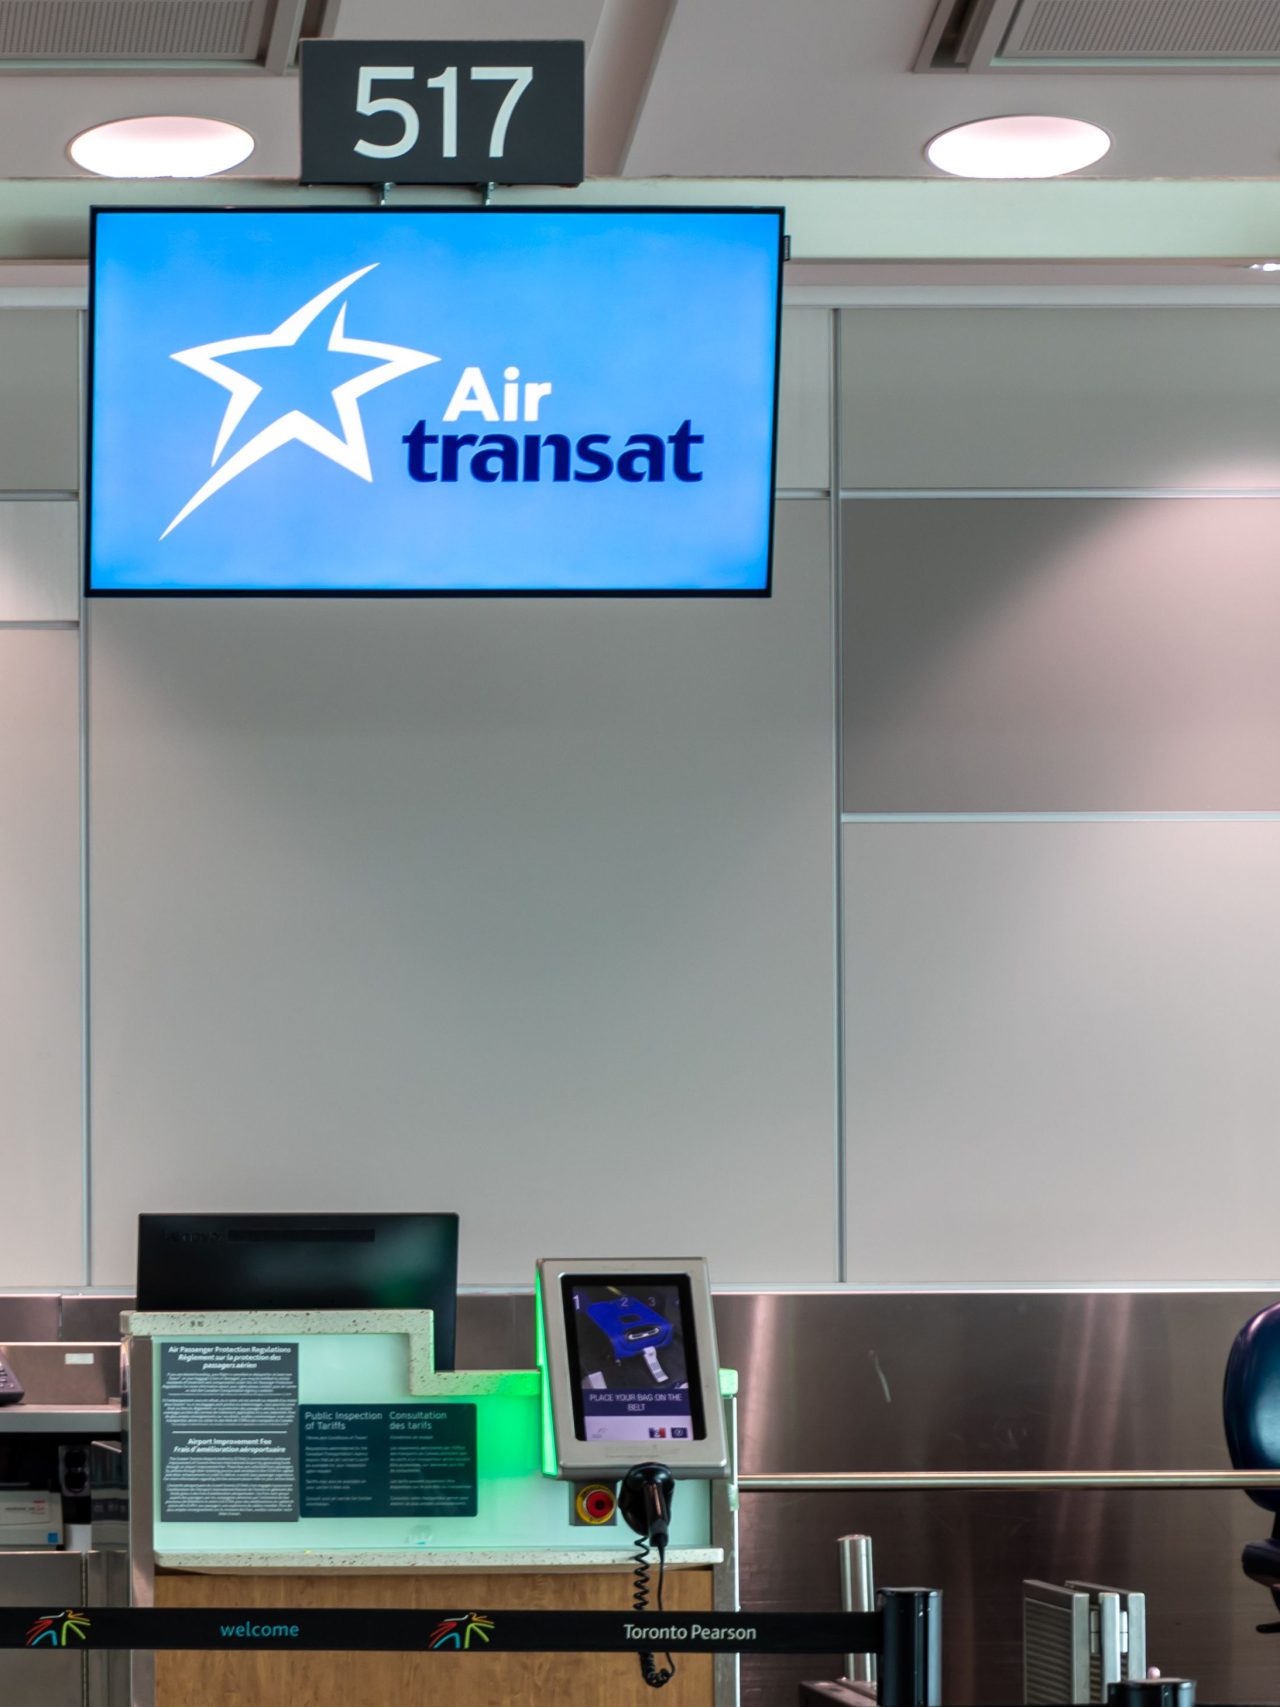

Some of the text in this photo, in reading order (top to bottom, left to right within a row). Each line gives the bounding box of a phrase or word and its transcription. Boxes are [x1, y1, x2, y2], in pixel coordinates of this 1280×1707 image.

[354, 67, 533, 158] 517
[443, 367, 552, 421] Air
[403, 420, 704, 482] transat
[180, 1346, 214, 1355] Passenger
[251, 1346, 292, 1355] Regulations
[178, 1354, 215, 1362] Règlement
[233, 1354, 269, 1362] protection
[305, 1412, 382, 1420] Public Inspection
[389, 1411, 446, 1419] Consultation
[305, 1422, 346, 1430] of Tariffs
[408, 1421, 432, 1429] tarifs
[187, 1438, 213, 1446] Airport
[213, 1438, 259, 1446] Improvement
[221, 1621, 299, 1636] welcome
[624, 1624, 756, 1639] Toronto Pearson
